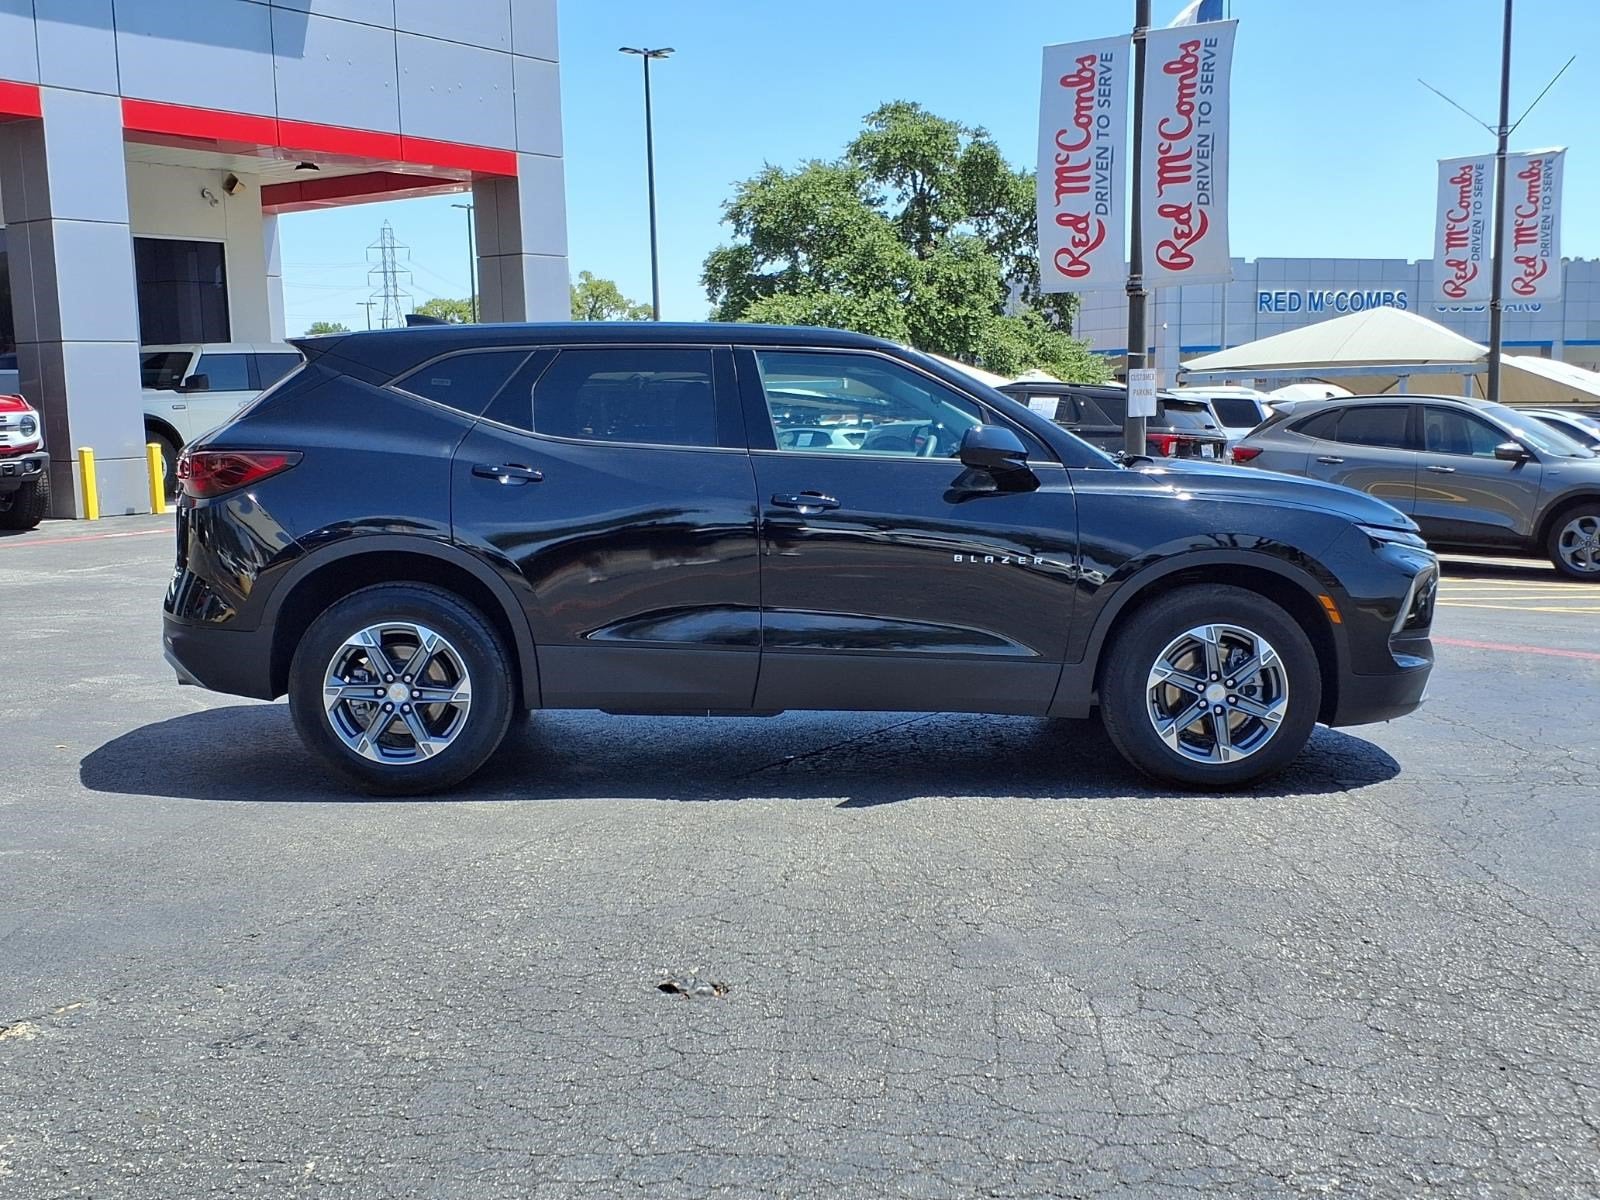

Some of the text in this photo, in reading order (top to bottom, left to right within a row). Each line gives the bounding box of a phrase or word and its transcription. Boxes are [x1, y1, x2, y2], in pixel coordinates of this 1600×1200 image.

[1054, 54, 1106, 278] Red McCombs
[1095, 52, 1114, 216] DRIVEN TO SERVE
[1156, 39, 1209, 271] Red McCombs
[1197, 37, 1218, 206] DRIVEN TO SERVE
[1445, 164, 1474, 255] McCombs
[1471, 163, 1485, 261] DRIVEN TO SERVE
[1513, 159, 1543, 253] McCombs
[1540, 158, 1554, 258] DRIVEN TO SERVE
[1258, 290, 1302, 313] RED
[1442, 258, 1478, 298] Red
[1511, 254, 1548, 296] Red
[953, 554, 1043, 565] BLAZER
